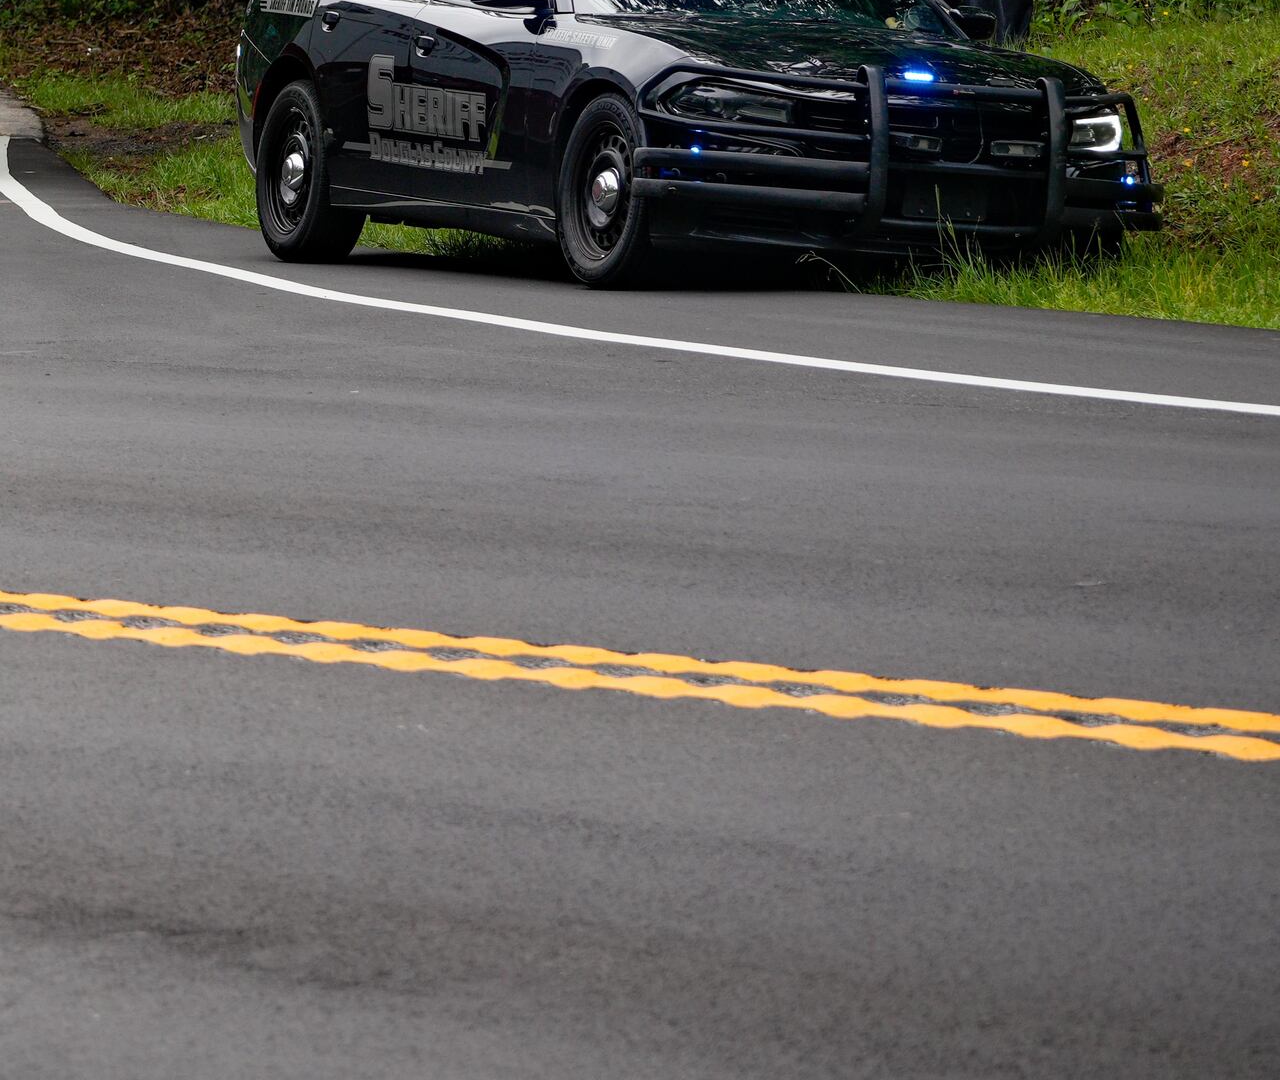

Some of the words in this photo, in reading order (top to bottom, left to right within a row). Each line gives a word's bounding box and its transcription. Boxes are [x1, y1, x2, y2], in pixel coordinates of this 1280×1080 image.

[543, 27, 571, 41] TRAFFIC
[571, 31, 597, 46] SAFETY
[596, 34, 618, 49] UNIT
[368, 54, 486, 142] SHERIFF
[369, 132, 432, 167] DOUGLAS
[432, 141, 487, 175] COUNTY
